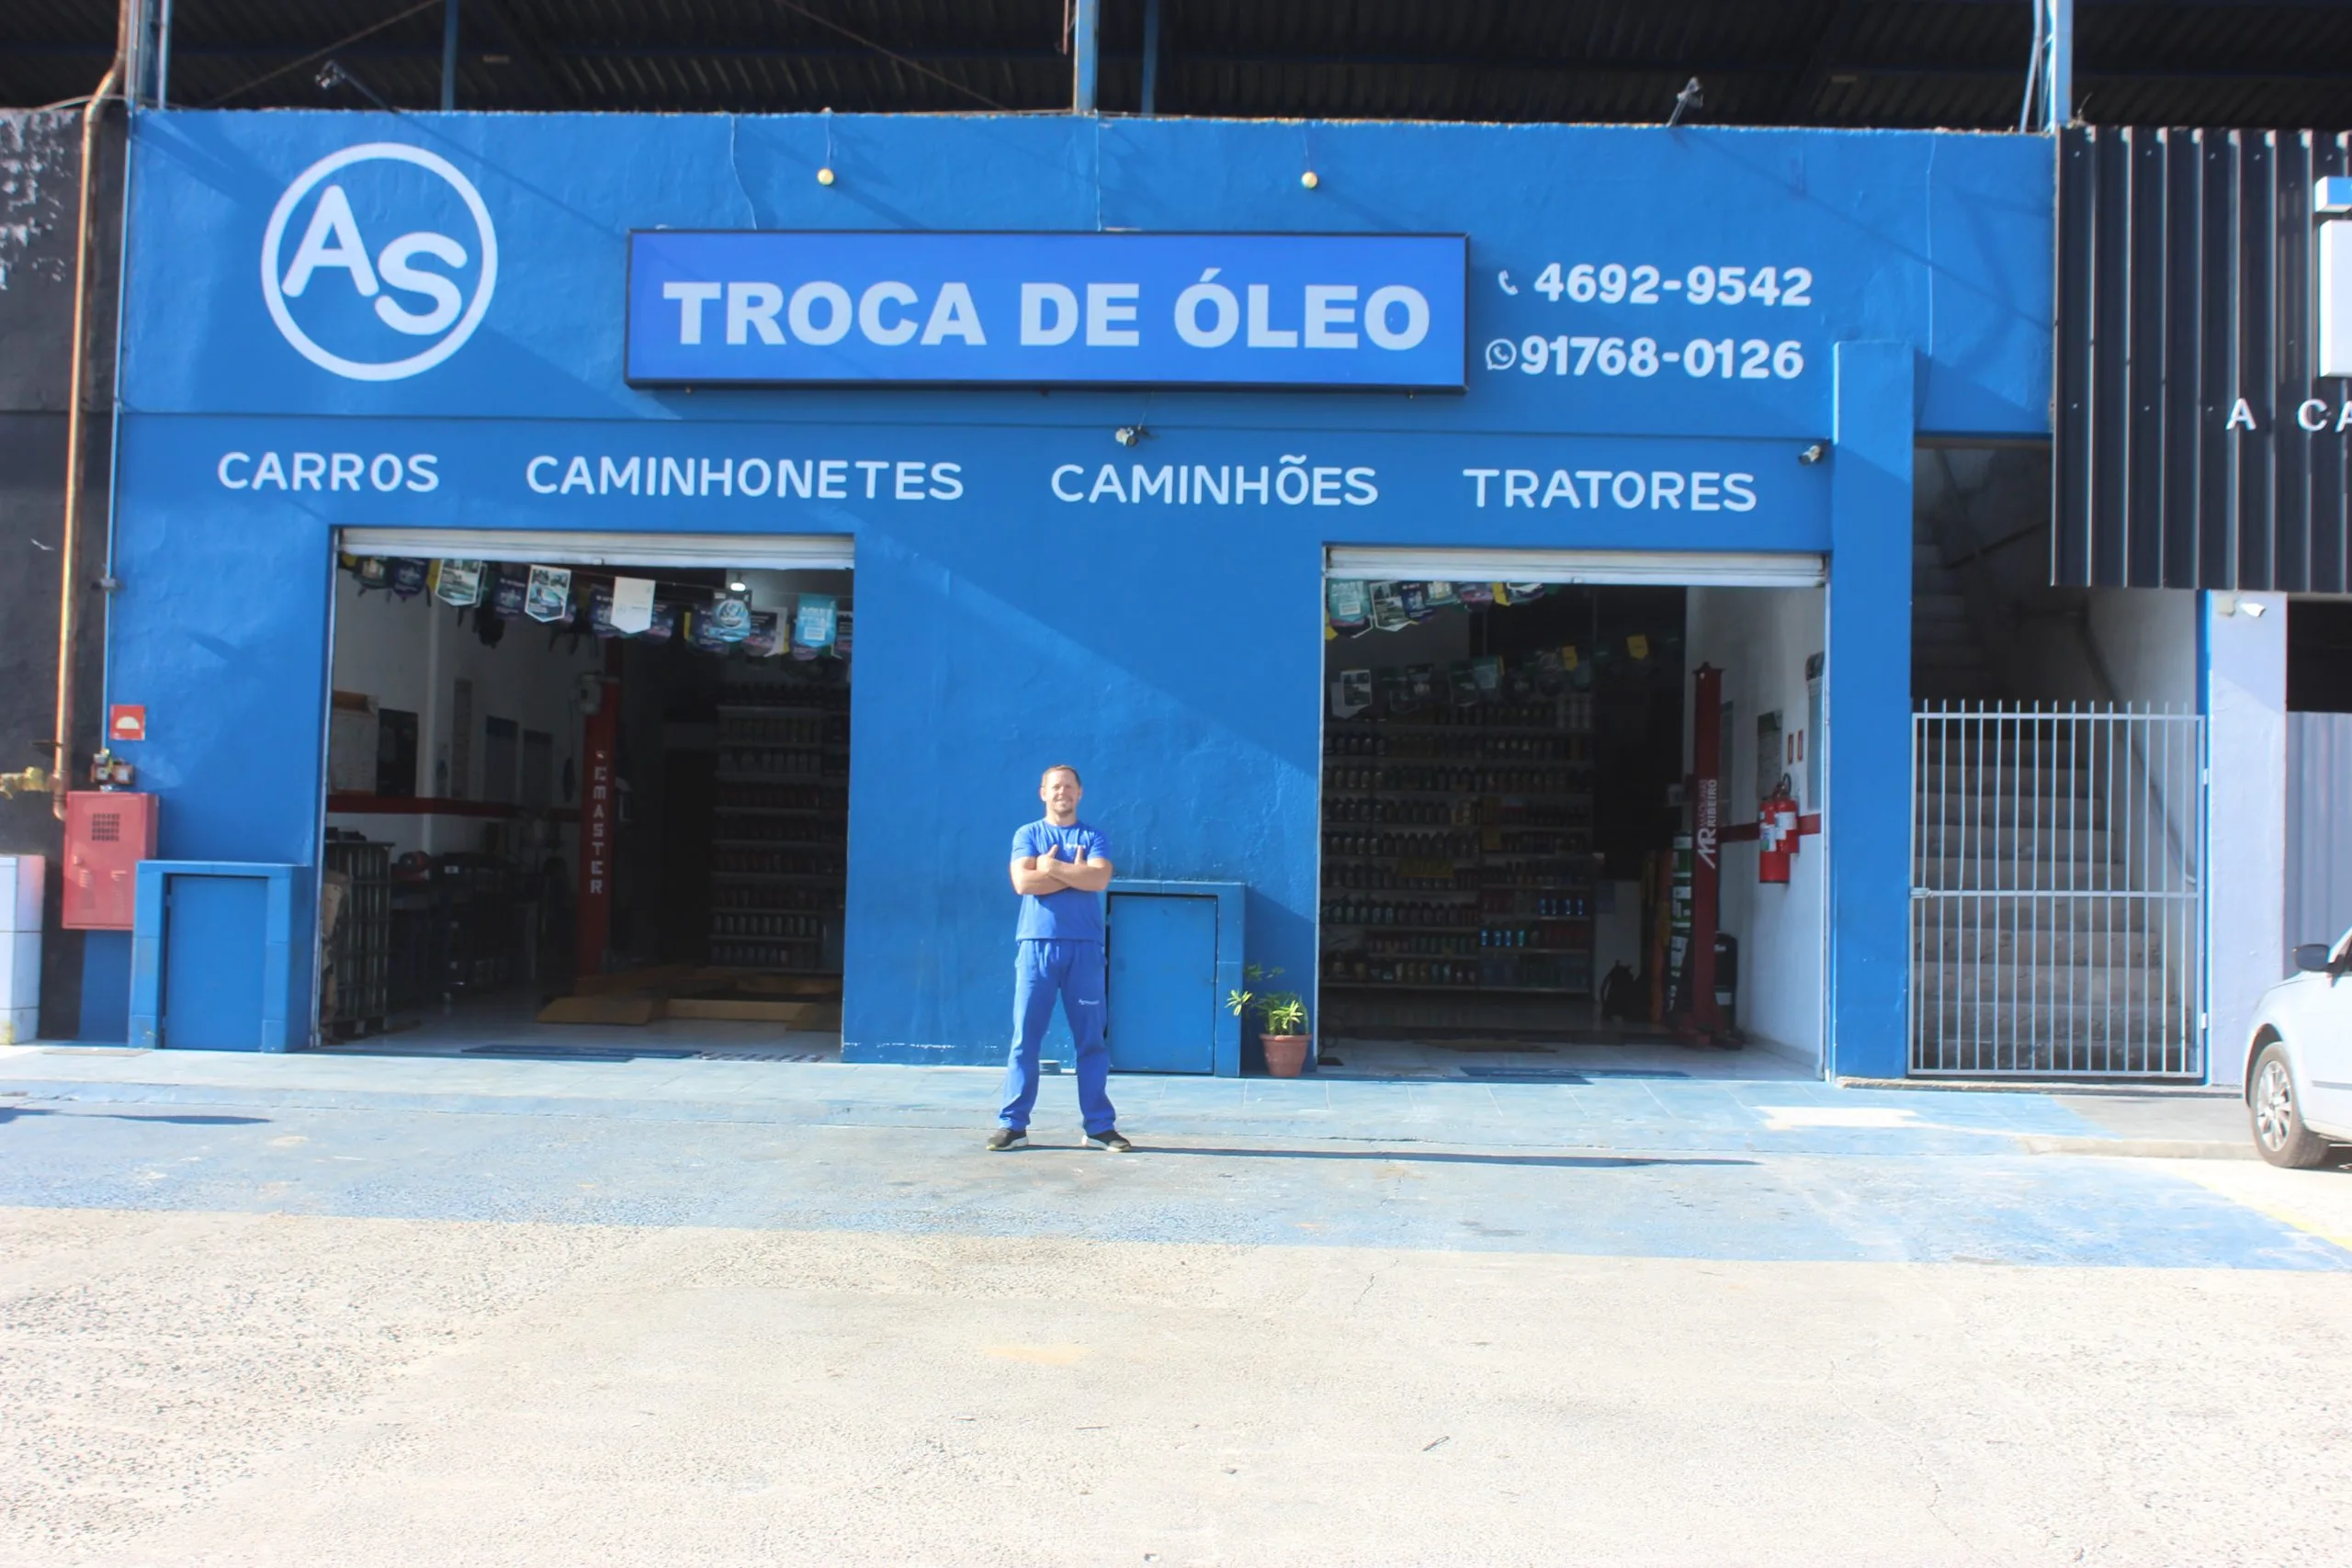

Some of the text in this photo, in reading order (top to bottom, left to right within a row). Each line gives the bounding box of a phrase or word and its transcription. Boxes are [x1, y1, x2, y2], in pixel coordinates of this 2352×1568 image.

[282, 184, 469, 337] AS
[1534, 263, 1814, 307] 4692-9542
[662, 267, 1430, 351] TROCA DE ÓLEO
[1521, 335, 1805, 379] 91768-0126
[2226, 397, 2257, 431] A
[217, 451, 439, 492] CARROS
[526, 455, 964, 501] CAMINHONETES
[1050, 454, 1379, 506] CAMINHÕES
[1462, 468, 1758, 513] TRATORES
[1707, 778, 1717, 828] RIBEIRO
